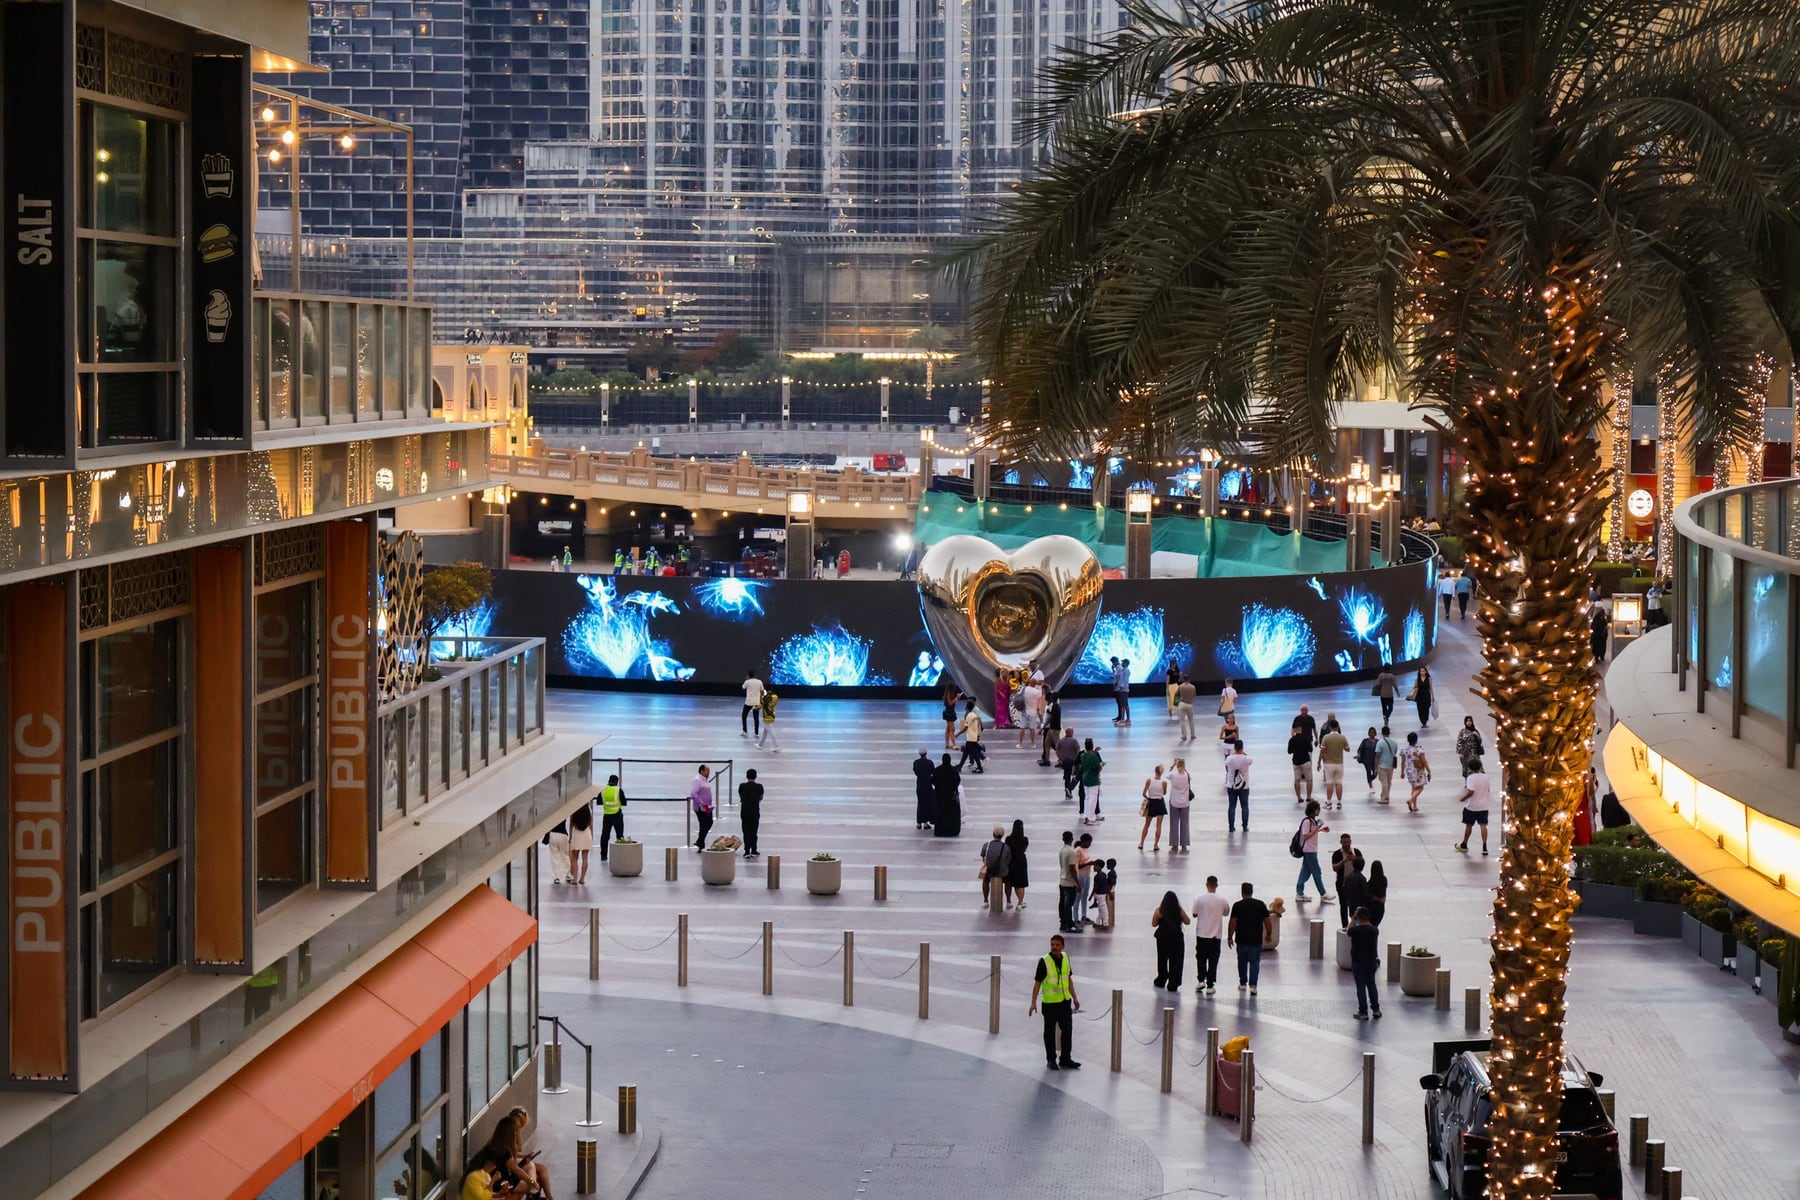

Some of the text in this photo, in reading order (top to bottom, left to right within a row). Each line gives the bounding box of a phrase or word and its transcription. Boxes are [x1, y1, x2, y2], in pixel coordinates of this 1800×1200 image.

[18, 194, 52, 265] SALT
[331, 614, 365, 788] PUBLIC
[14, 713, 62, 952] PUBLIC
